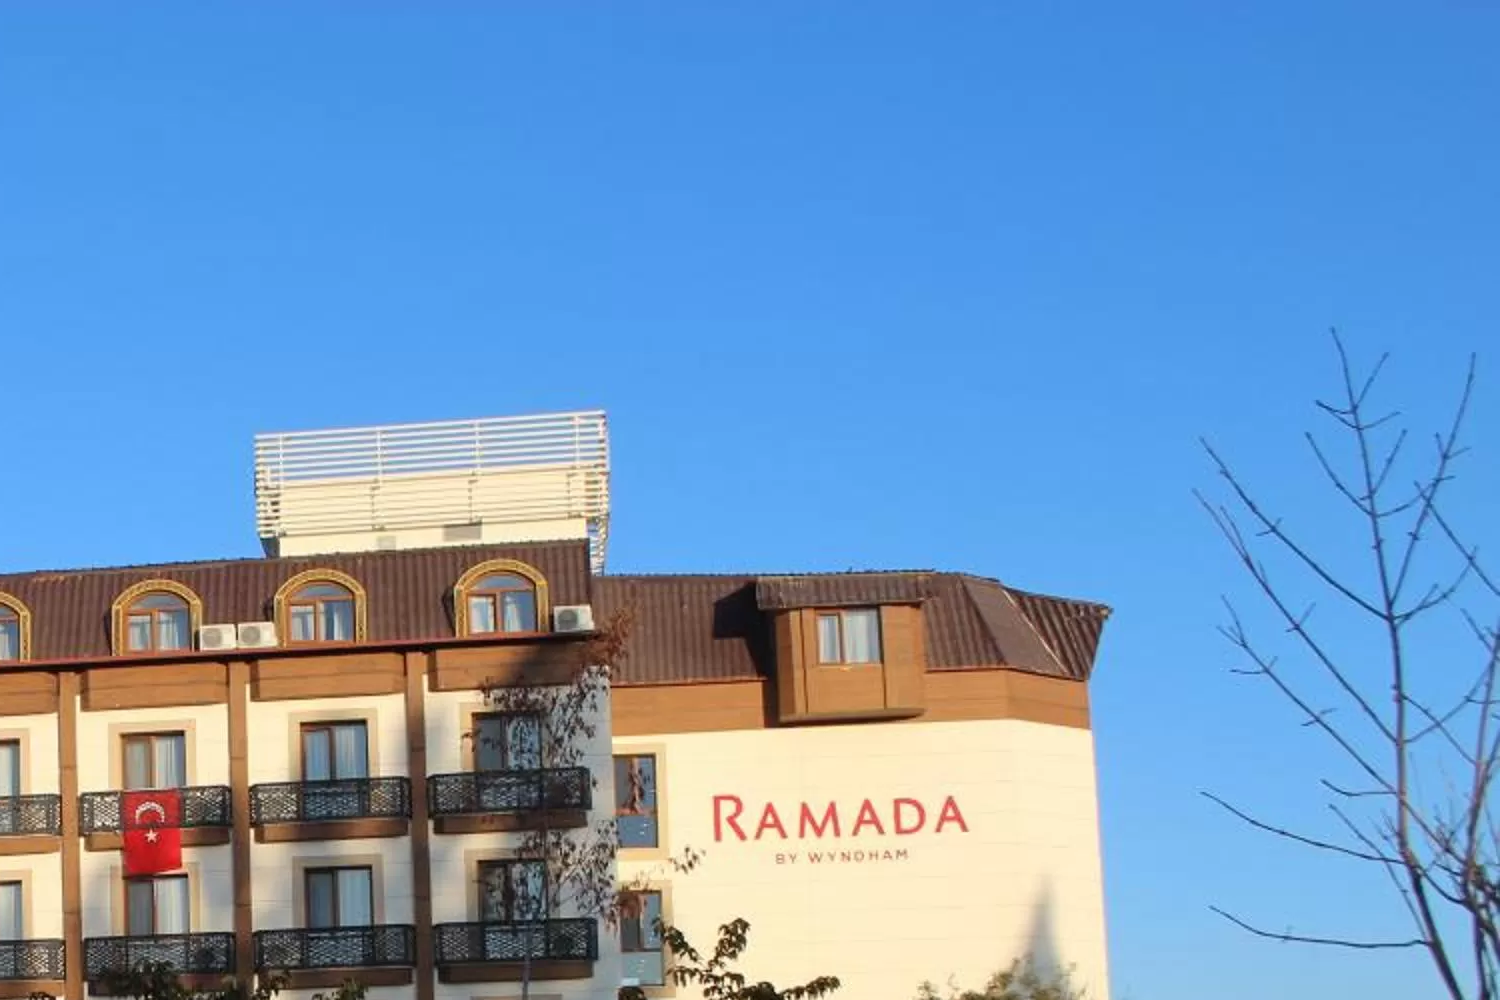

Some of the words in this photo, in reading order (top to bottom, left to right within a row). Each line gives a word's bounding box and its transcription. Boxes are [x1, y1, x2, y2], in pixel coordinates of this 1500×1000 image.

[713, 794, 969, 842] RAMADA
[775, 852, 797, 865] BY
[808, 848, 909, 864] WYNDHAM
